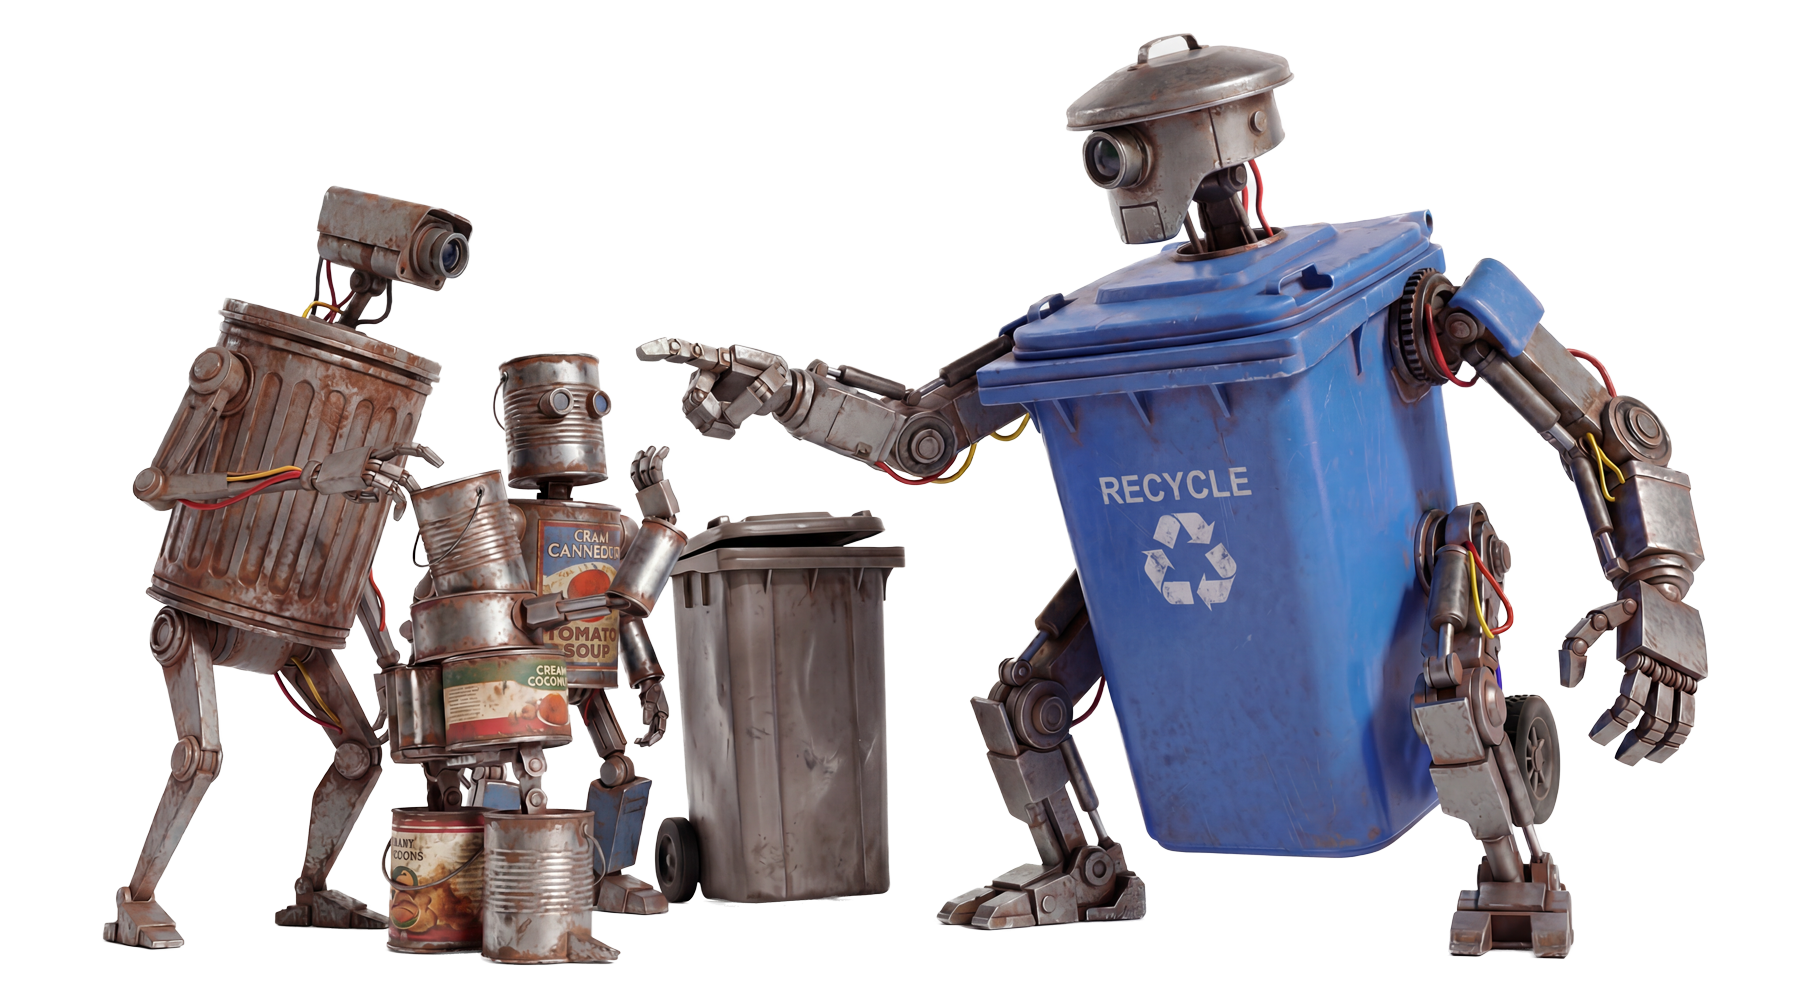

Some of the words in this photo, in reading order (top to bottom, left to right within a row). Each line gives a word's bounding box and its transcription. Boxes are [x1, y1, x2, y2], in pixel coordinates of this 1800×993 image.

[1098, 466, 1253, 505] RECYCLE
[574, 529, 609, 544] CRAM
[548, 626, 617, 642] TOMATO
[563, 643, 610, 659] SOUP
